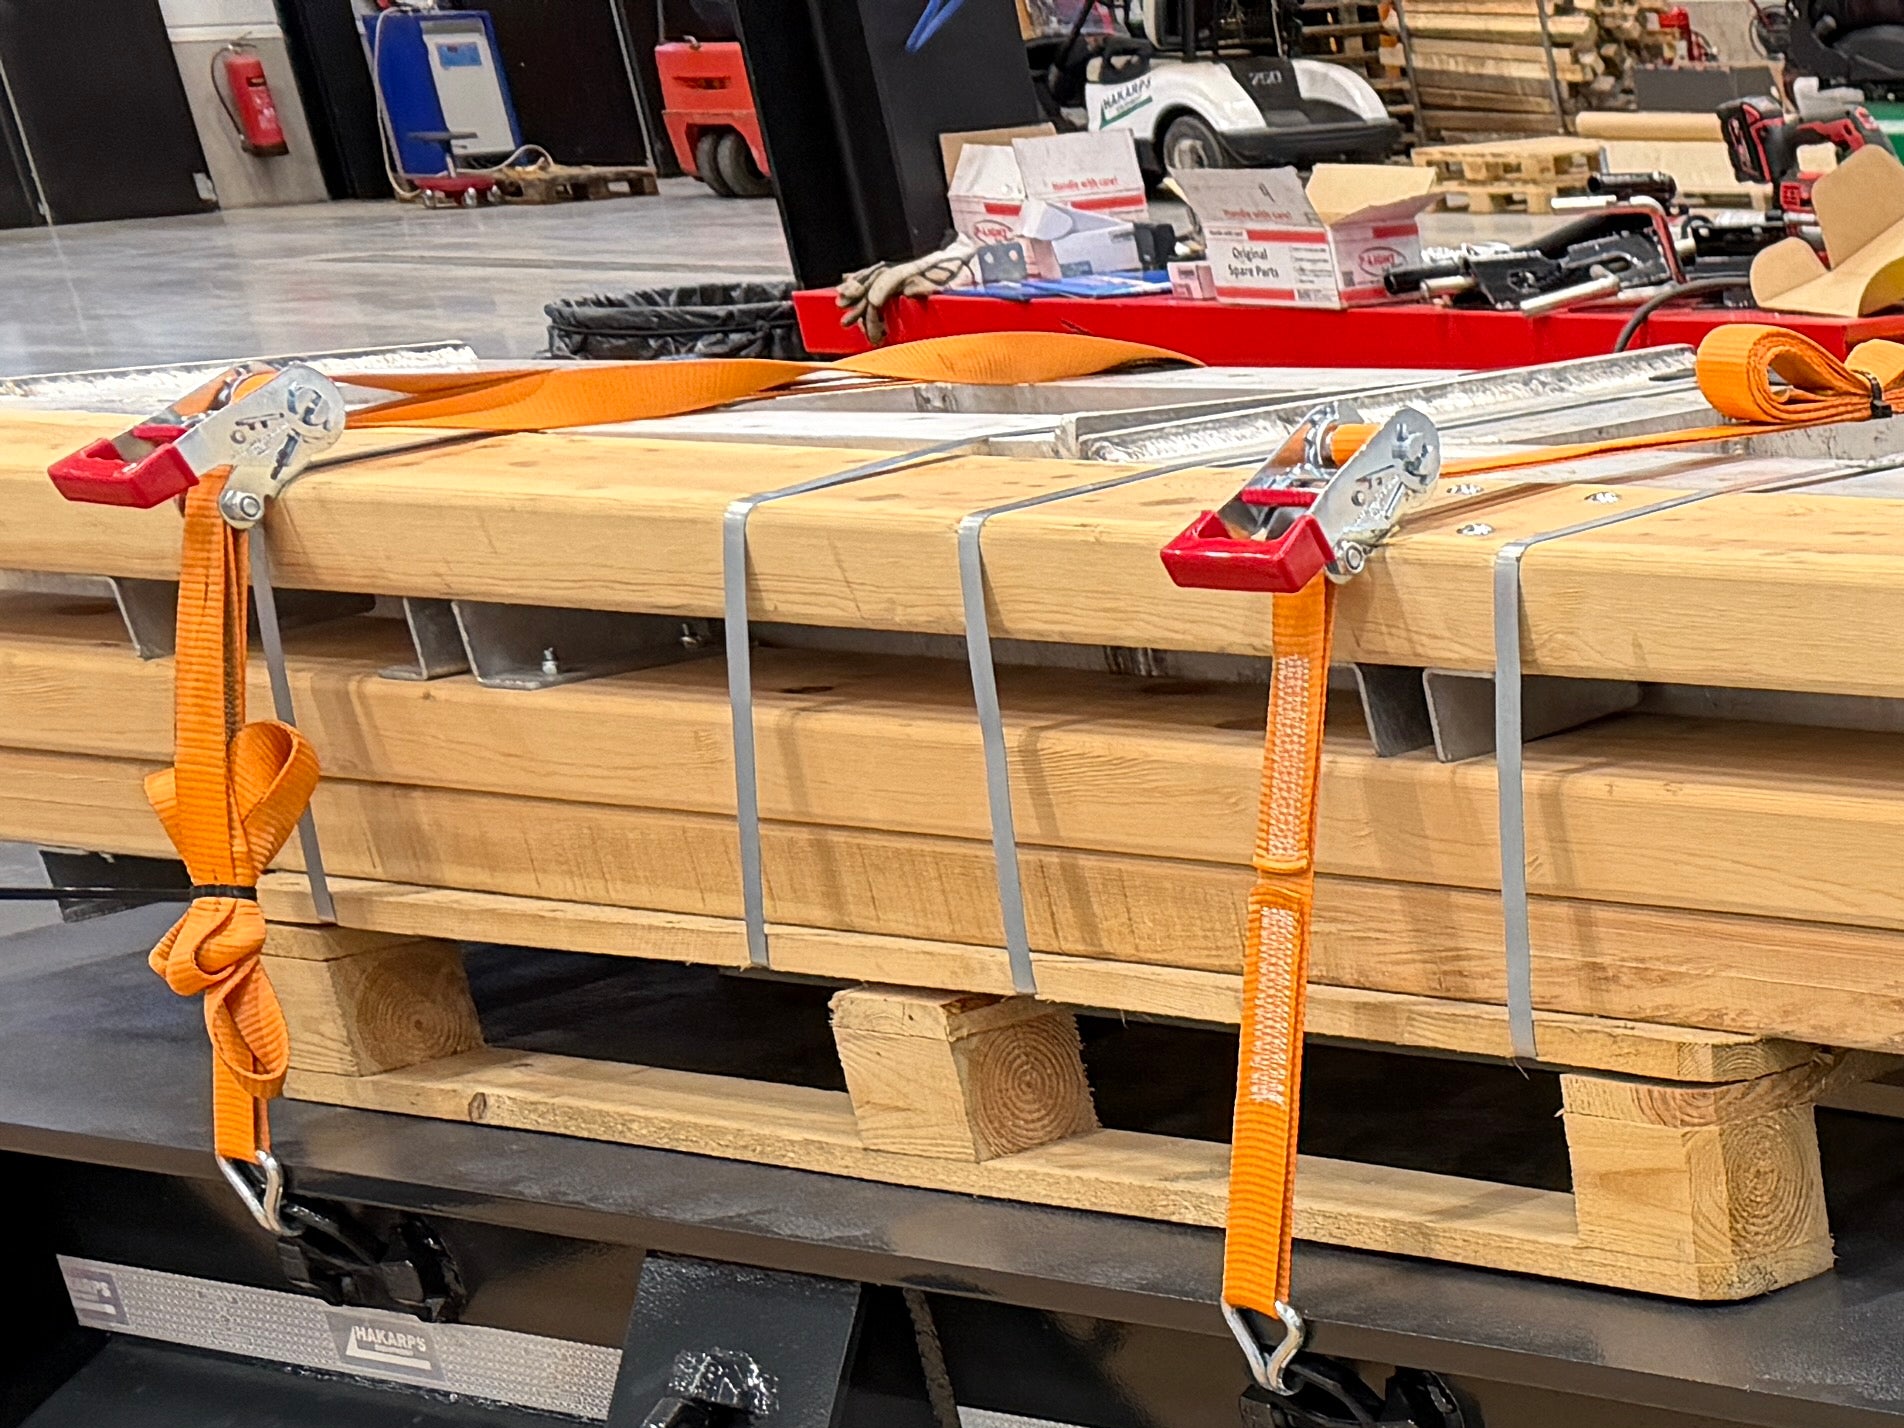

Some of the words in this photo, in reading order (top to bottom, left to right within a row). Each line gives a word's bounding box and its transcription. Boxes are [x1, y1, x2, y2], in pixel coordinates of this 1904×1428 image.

[1231, 246, 1268, 263] Original
[1228, 263, 1254, 279] Spare
[1255, 264, 1279, 278] Parts
